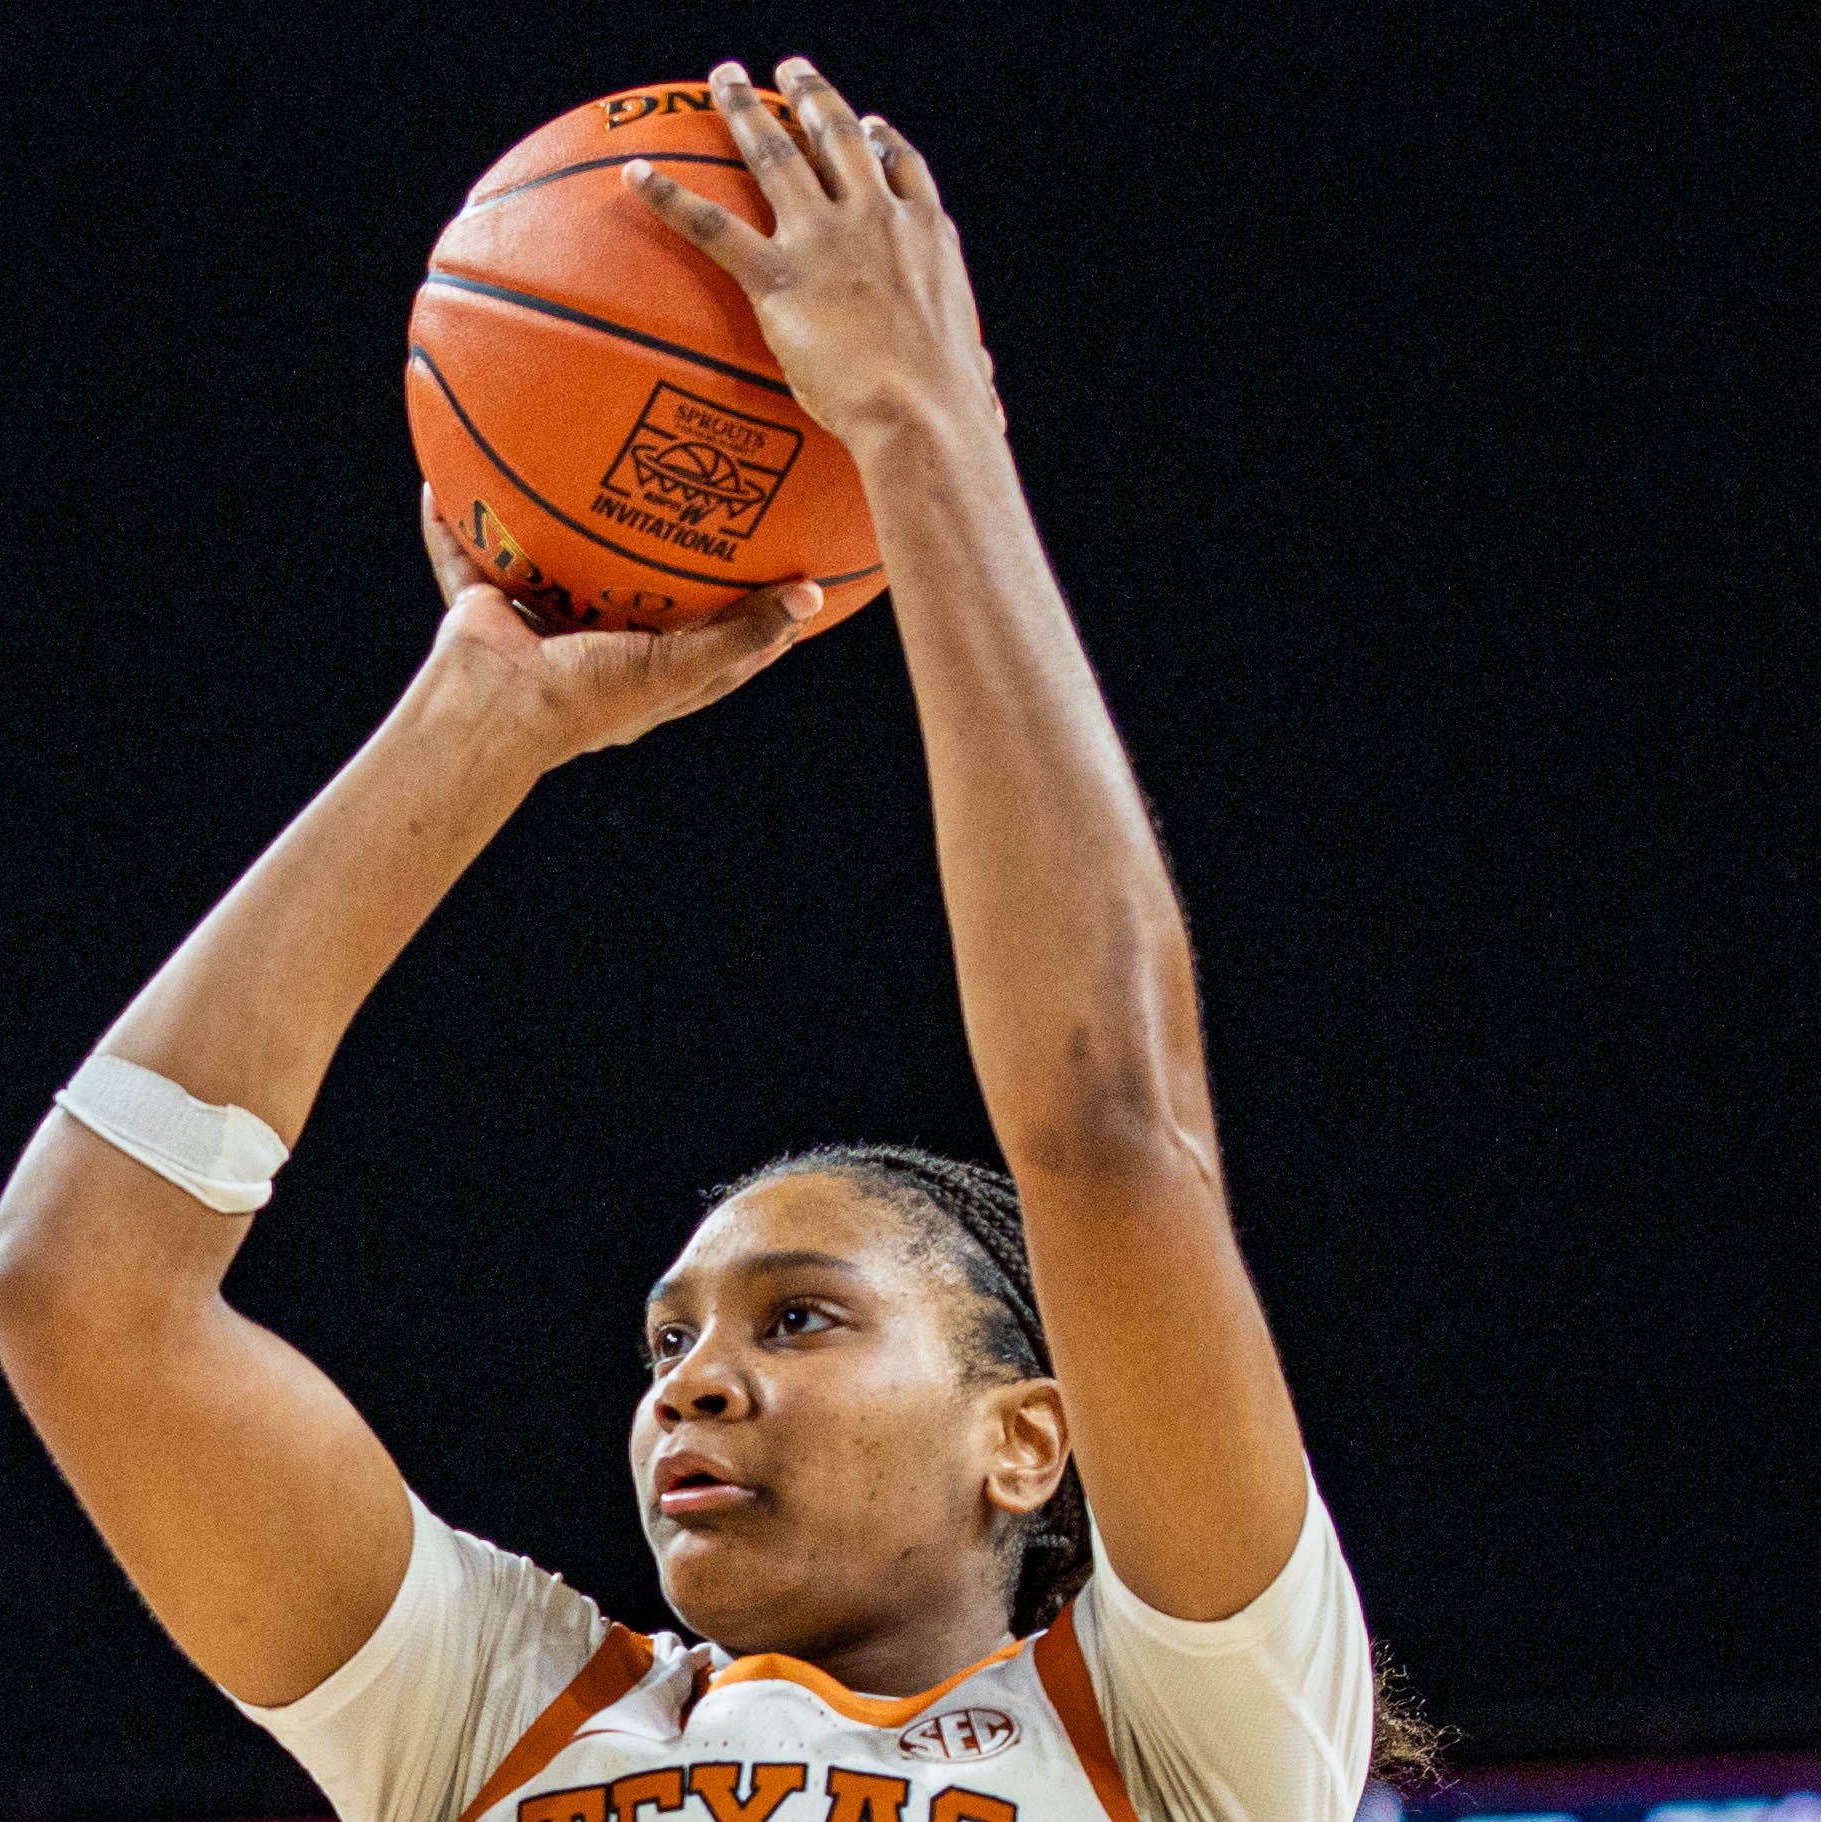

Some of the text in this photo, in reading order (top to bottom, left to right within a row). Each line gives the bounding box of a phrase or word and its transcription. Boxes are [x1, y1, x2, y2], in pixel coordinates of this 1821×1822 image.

[676, 403, 765, 450] SPROUTS
[591, 493, 738, 563] INVITATIONAL
[899, 1709, 1017, 1760] SEC
